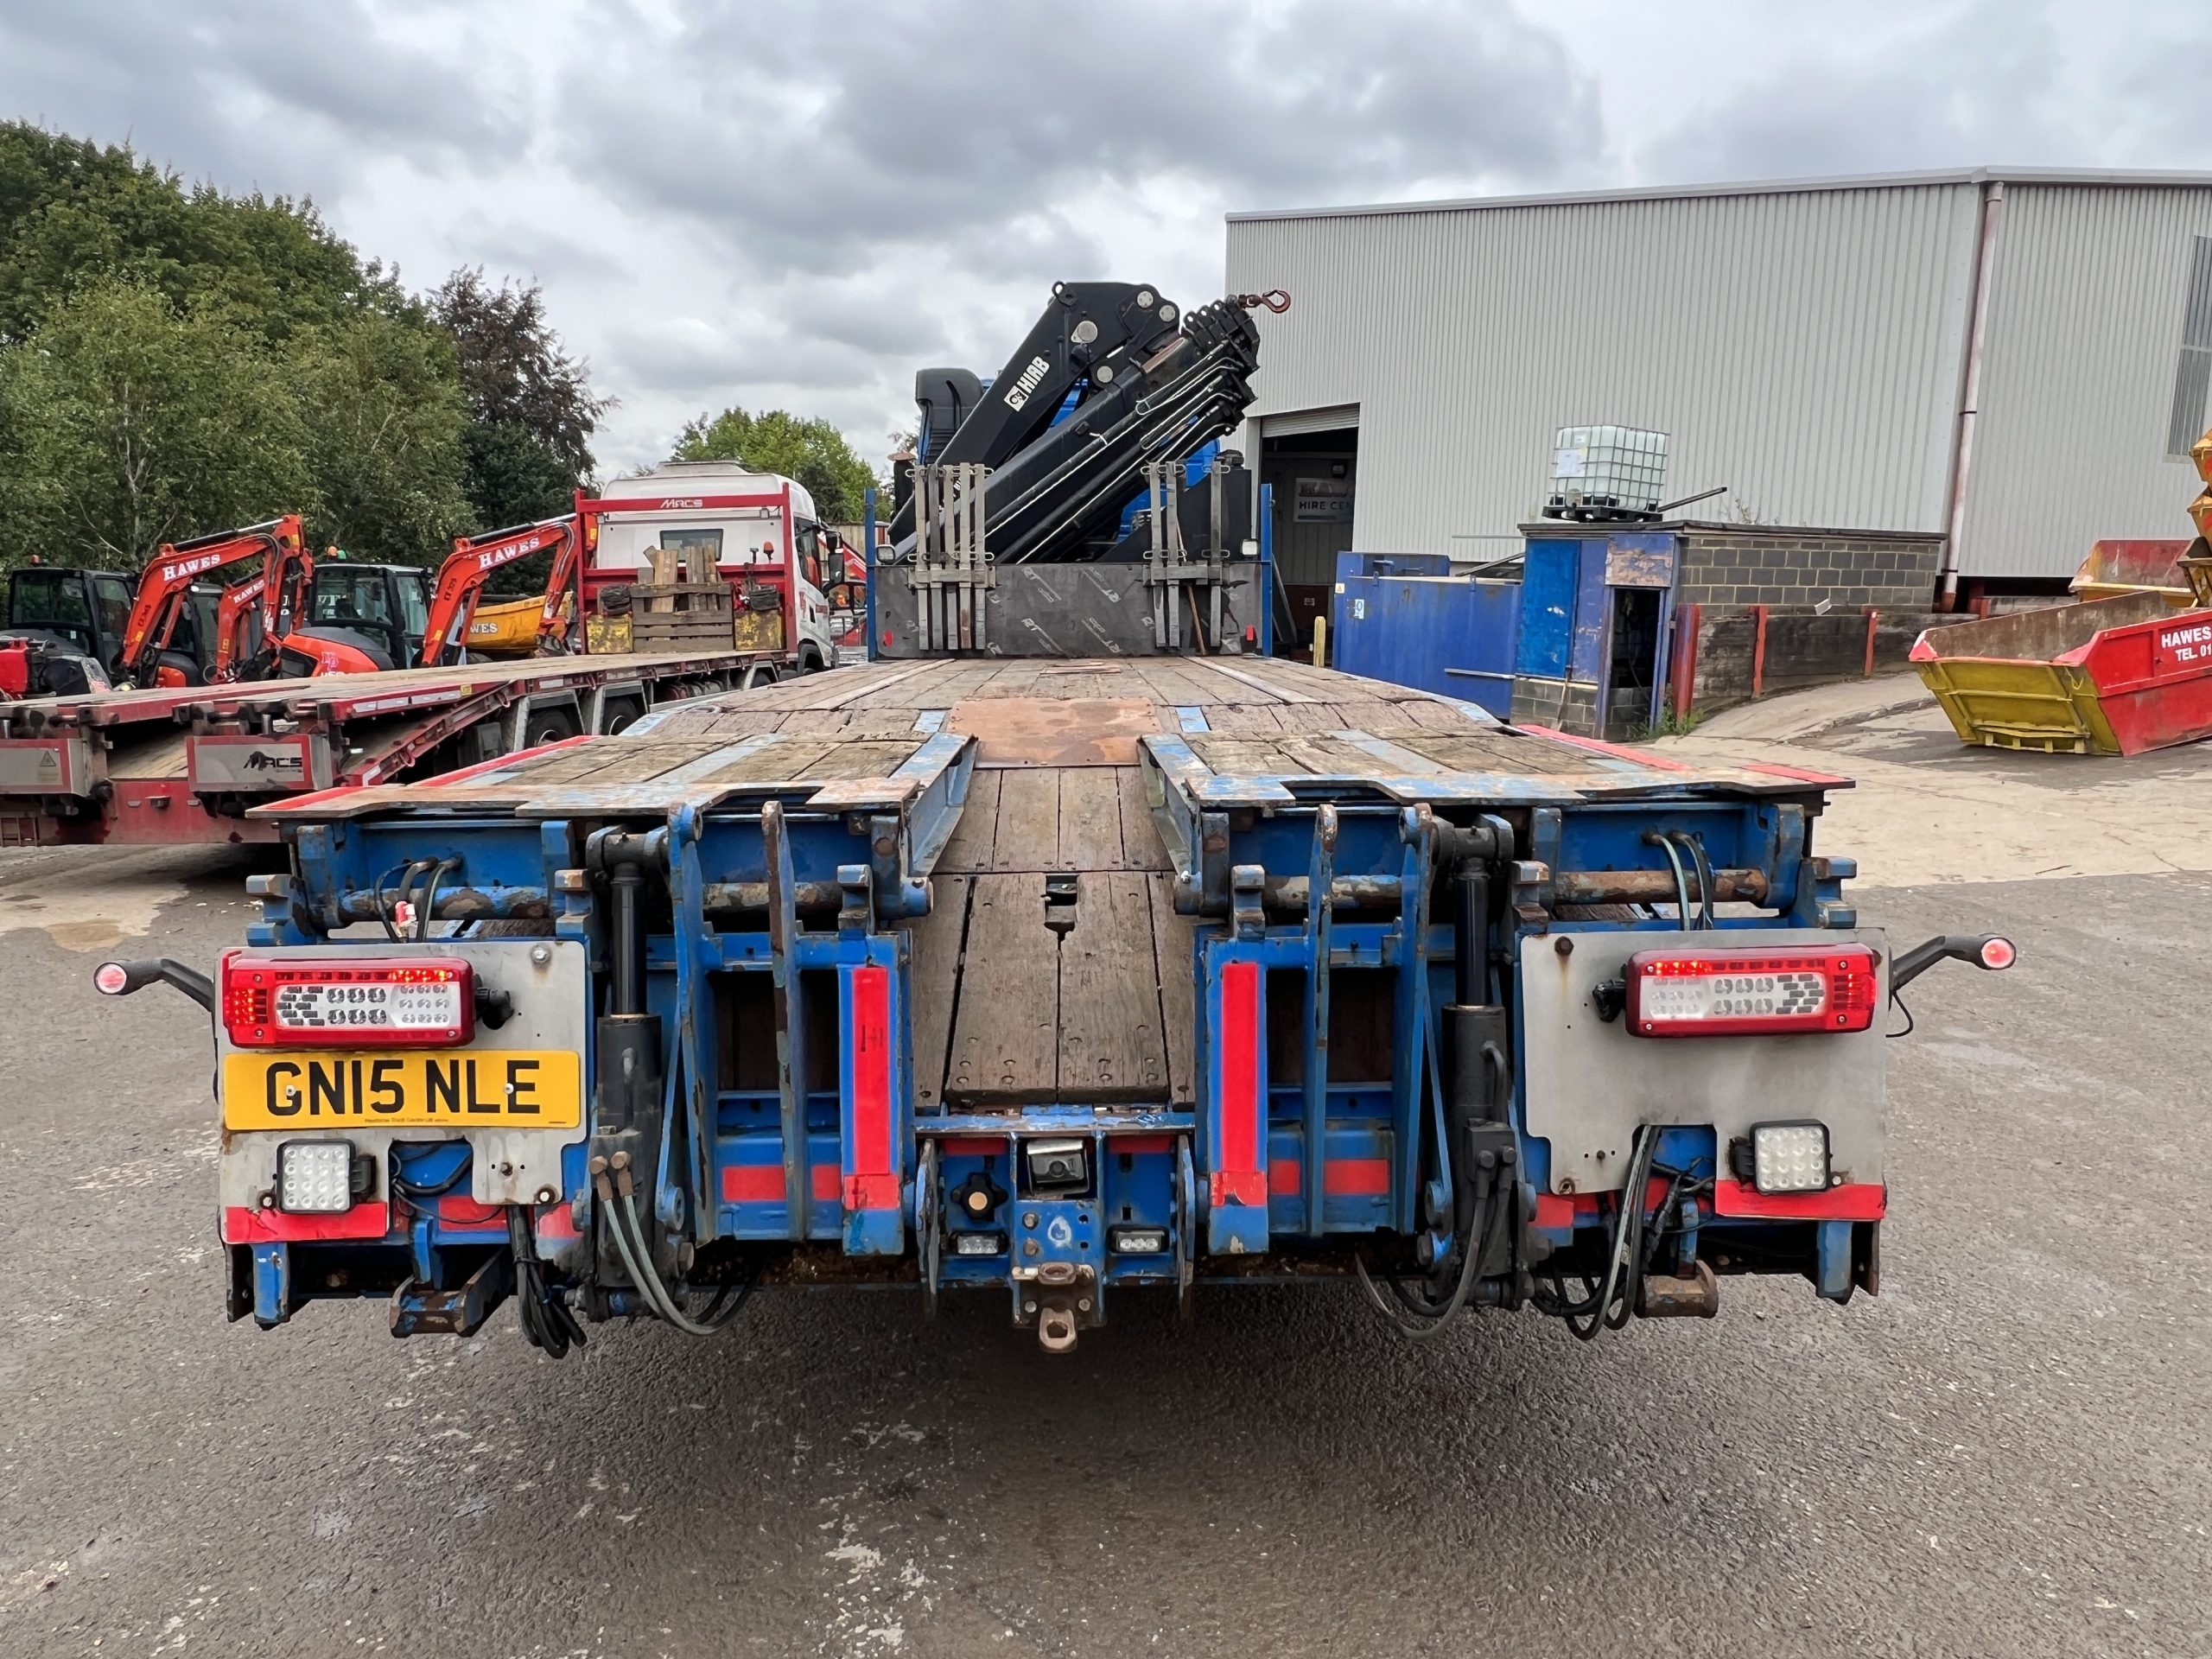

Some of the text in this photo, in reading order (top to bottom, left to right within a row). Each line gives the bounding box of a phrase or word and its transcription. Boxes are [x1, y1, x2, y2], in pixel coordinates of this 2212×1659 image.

[1016, 356, 1050, 394] HIAB
[1299, 501, 1326, 510] HIRE
[479, 537, 540, 570] HAWES
[162, 554, 221, 582] HAWES
[2161, 626, 2212, 649] HAWES
[243, 751, 303, 772] MACS
[266, 1058, 540, 1116] GN15 NLE
